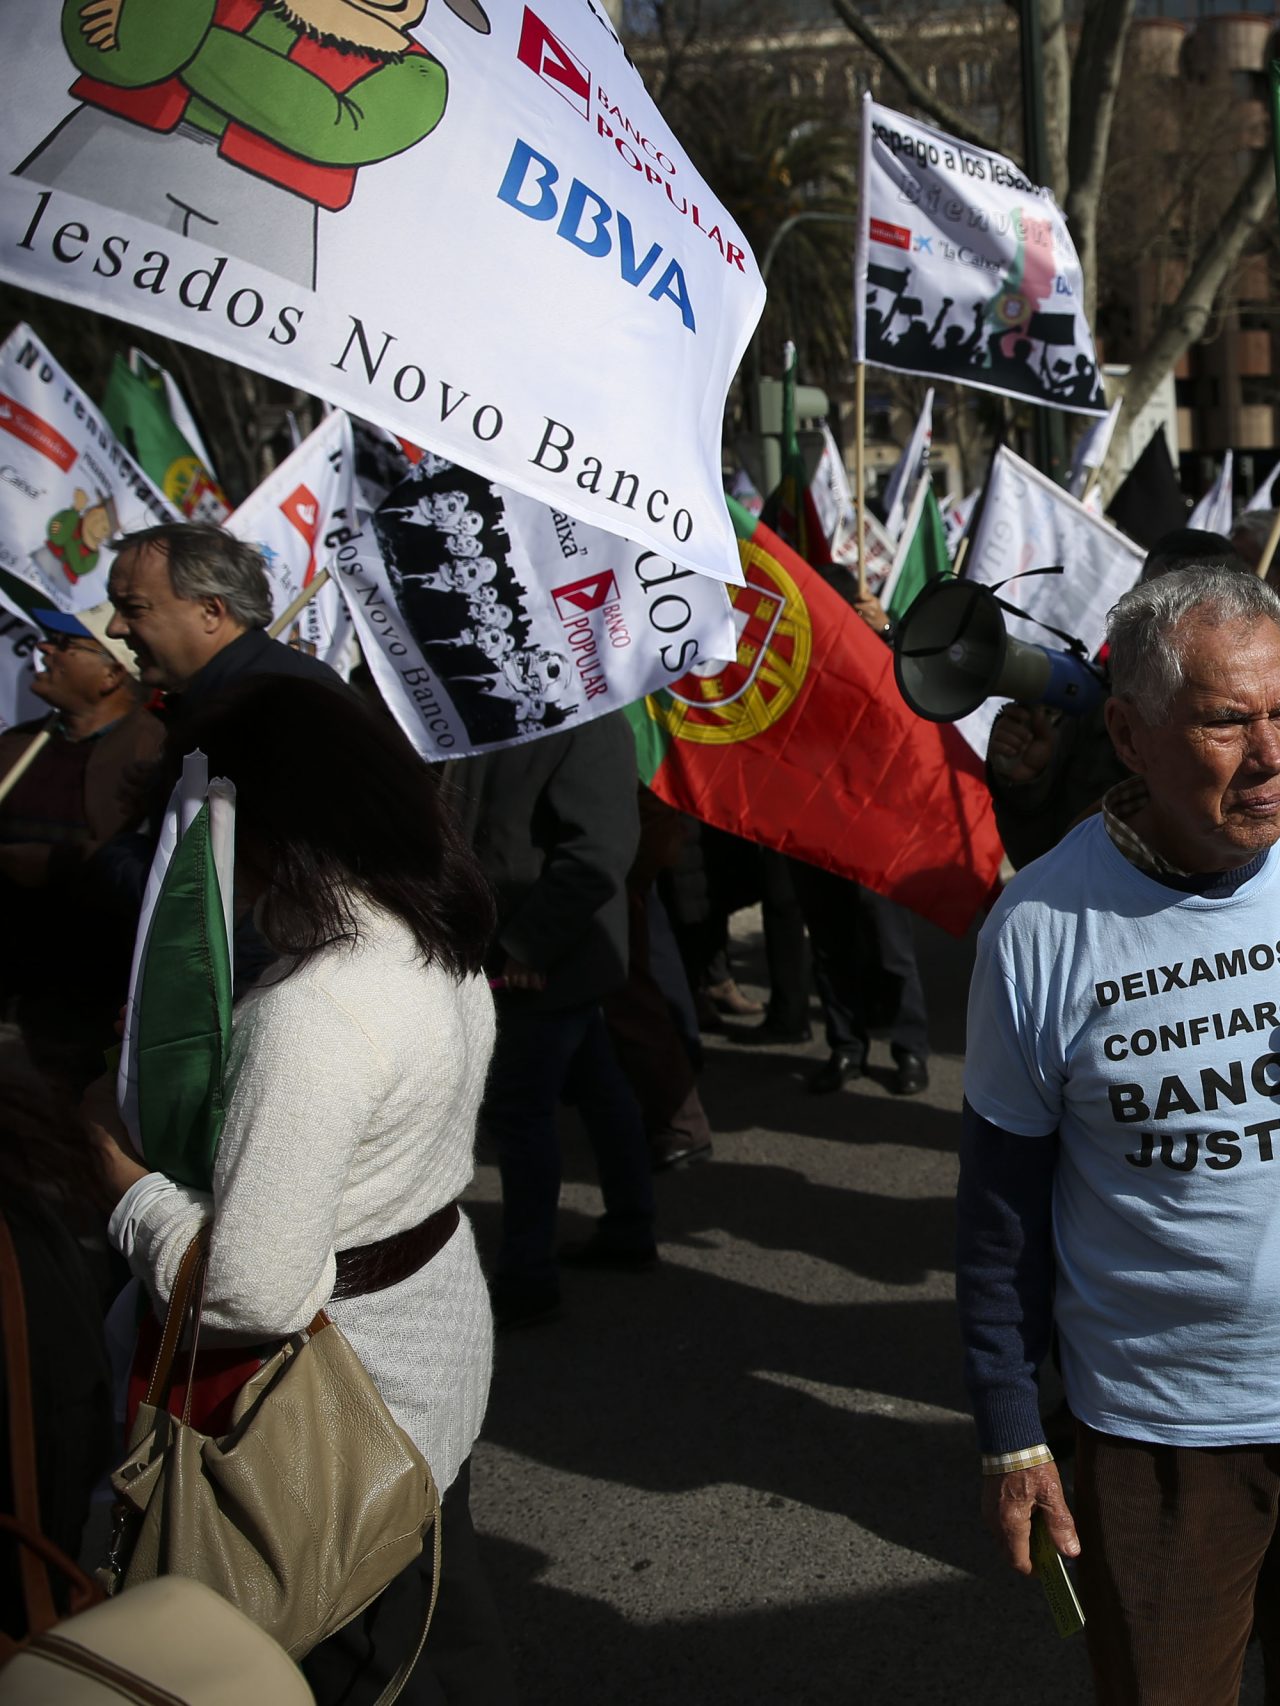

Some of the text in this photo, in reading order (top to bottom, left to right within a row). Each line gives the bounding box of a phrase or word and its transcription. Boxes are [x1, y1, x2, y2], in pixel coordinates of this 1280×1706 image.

[597, 85, 676, 175] BANCO
[944, 148, 956, 171] a
[958, 147, 986, 180] los
[496, 137, 697, 335] BBVA
[597, 113, 746, 274] POPULAR
[16, 191, 693, 542] lesados Novo Banco
[550, 508, 588, 558] aixa"
[356, 582, 408, 658] Novo
[401, 666, 456, 749] Banco
[563, 617, 608, 700] POPULAR
[601, 603, 631, 649] BANCO
[1103, 1001, 1280, 1062] CONFIAR
